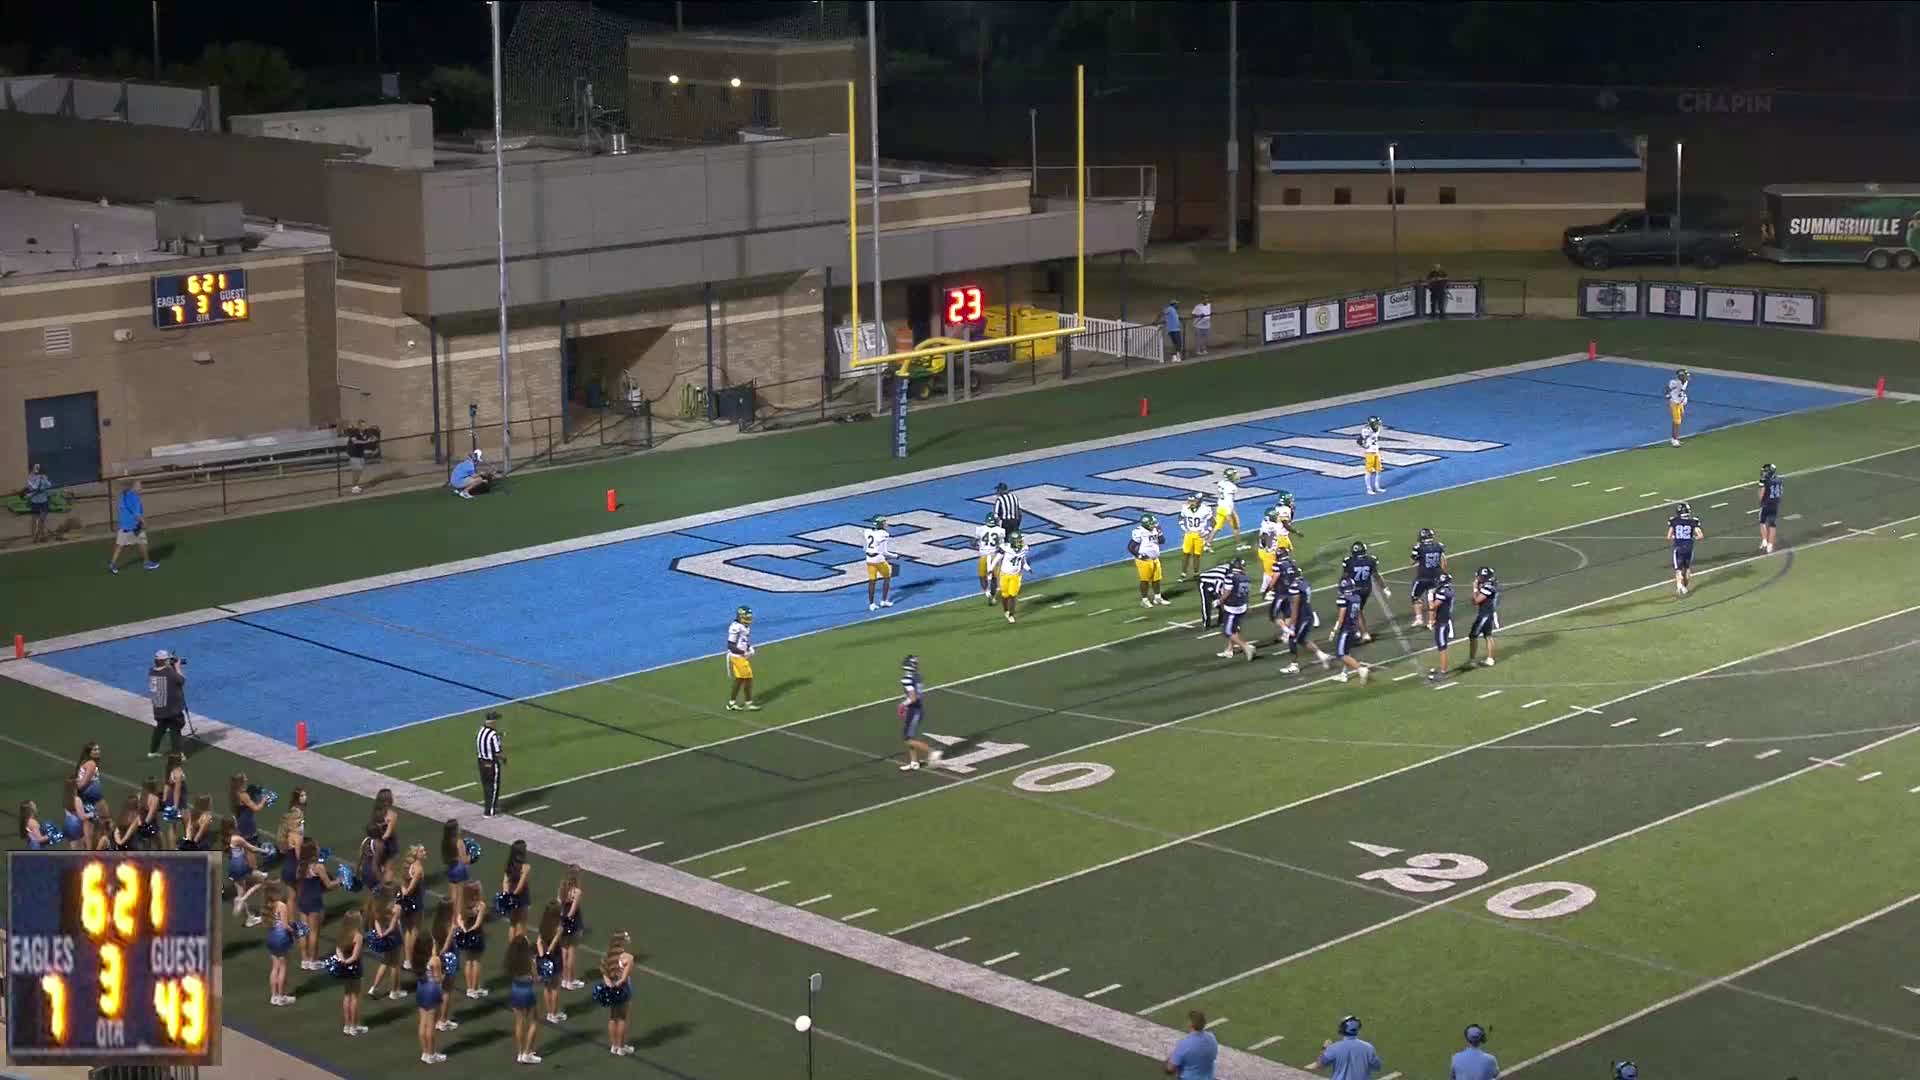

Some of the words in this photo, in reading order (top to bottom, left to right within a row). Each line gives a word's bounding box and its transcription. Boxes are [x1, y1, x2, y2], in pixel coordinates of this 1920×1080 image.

[1678, 92, 1773, 113] CHAPIN
[1789, 217, 1902, 236] SUMMERVILLE
[157, 296, 185, 307] EAGLES
[219, 288, 245, 301] GUEST
[196, 295, 208, 314] 3
[949, 289, 981, 322] 23
[222, 299, 247, 317] 43
[671, 426, 1508, 595] CHAPIN
[1187, 517, 1201, 528] 50
[981, 532, 999, 547] 43
[1674, 525, 1691, 540] 82
[867, 535, 875, 549] 2
[1353, 566, 1371, 581] 76
